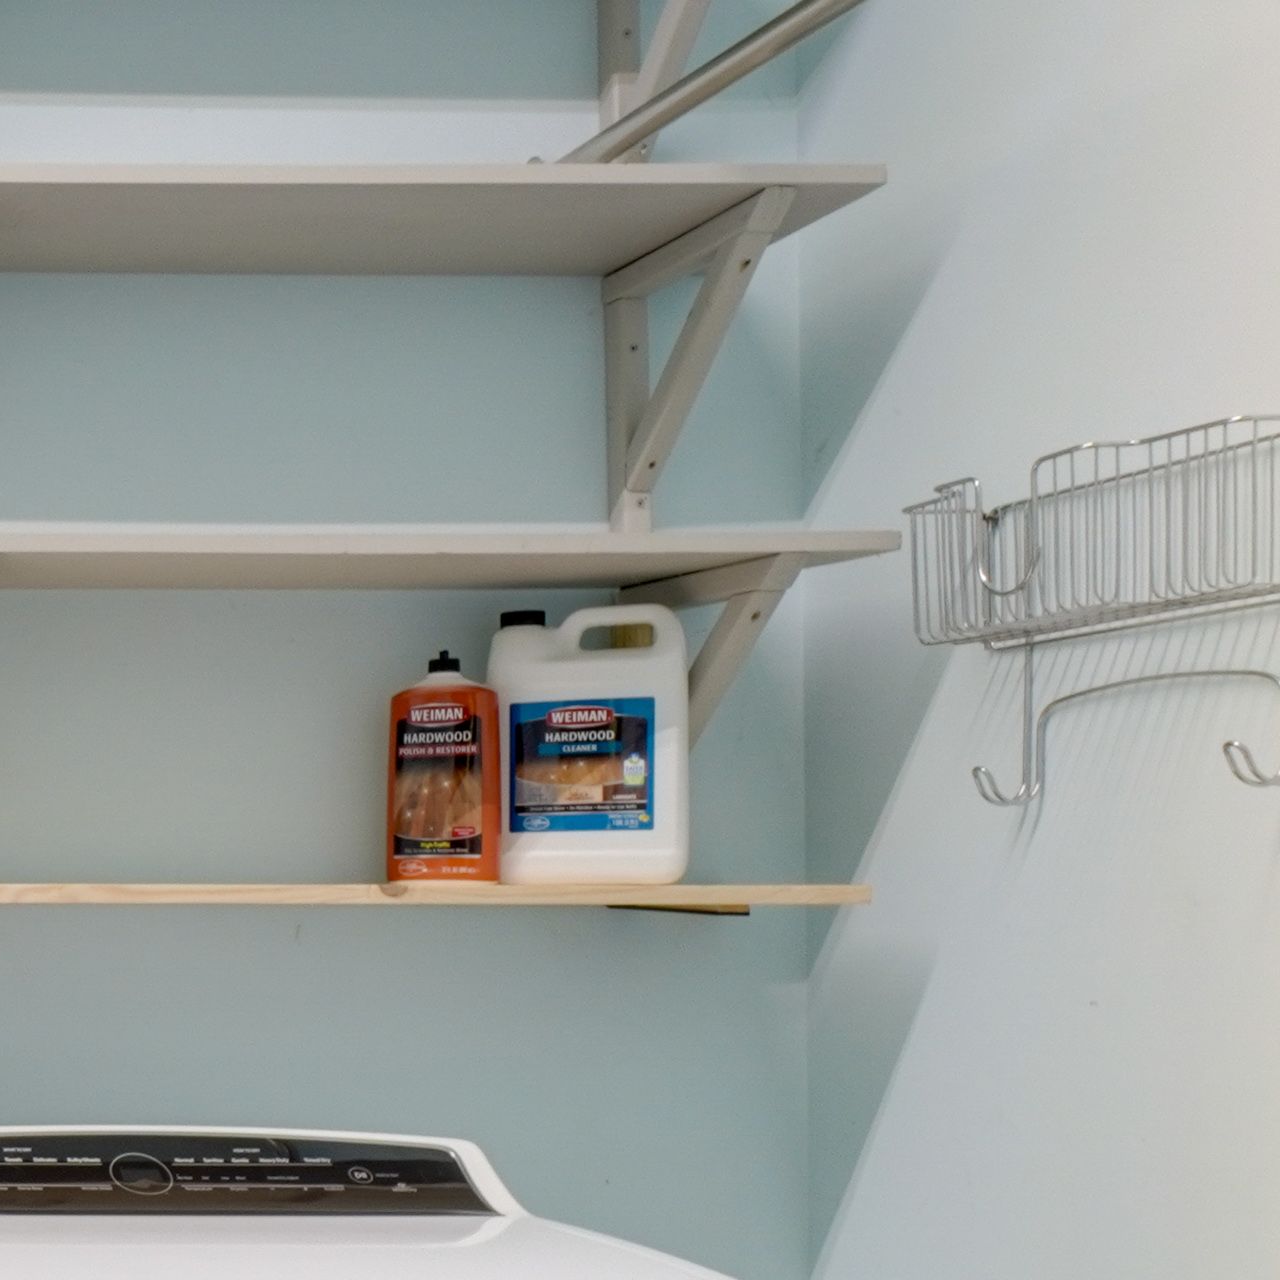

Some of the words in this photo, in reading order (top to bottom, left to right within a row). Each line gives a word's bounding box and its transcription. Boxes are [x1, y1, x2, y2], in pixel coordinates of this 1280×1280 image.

[411, 708, 464, 722] WEIMAN
[551, 709, 608, 723] WEIMAN
[403, 730, 472, 745] HARDWOOD
[545, 729, 616, 743] HARDWOOD
[399, 747, 425, 756] POLISH
[436, 744, 478, 754] RESTORER
[562, 744, 597, 753] CLEANER
